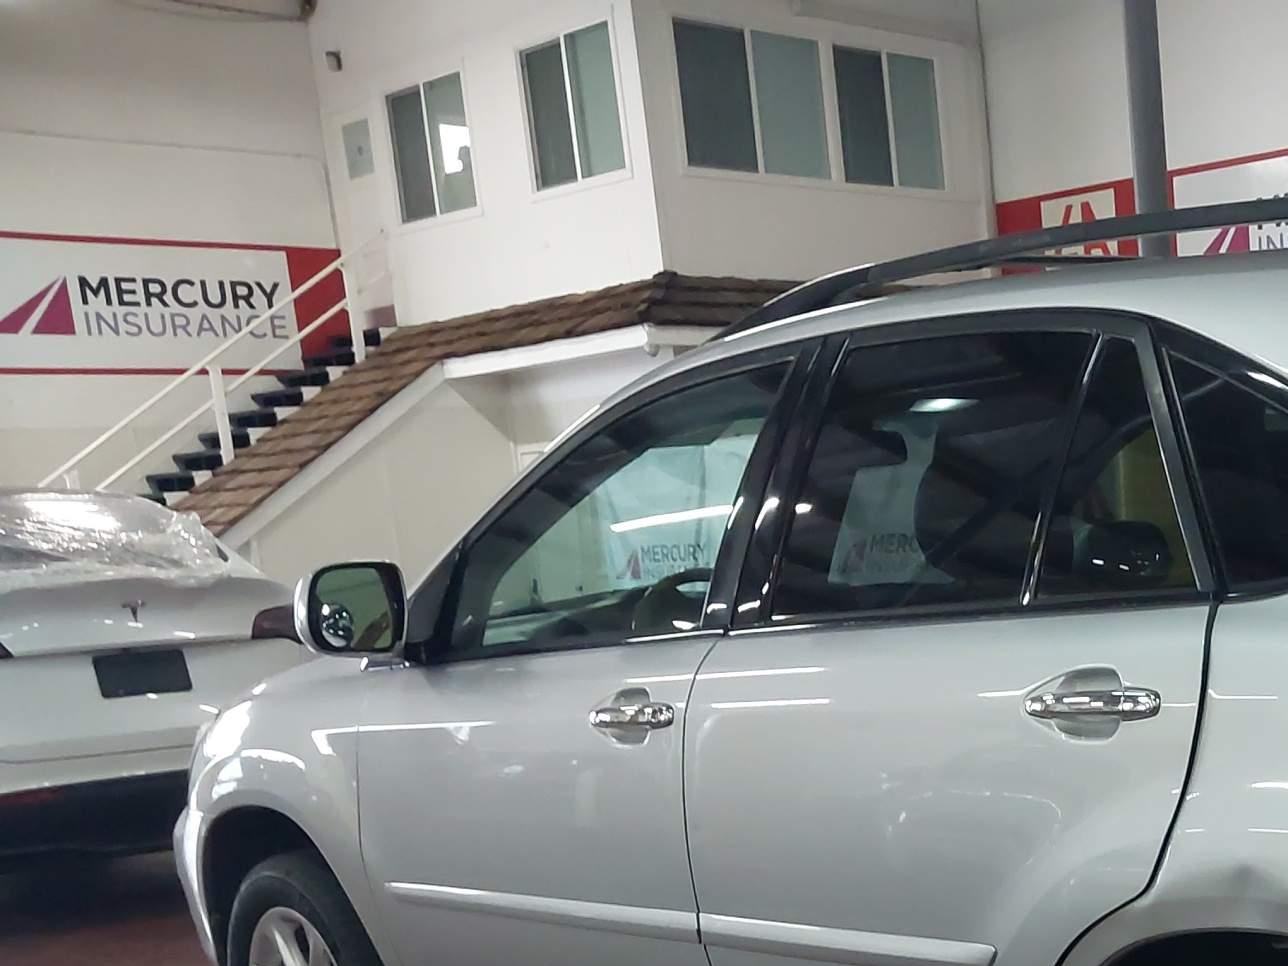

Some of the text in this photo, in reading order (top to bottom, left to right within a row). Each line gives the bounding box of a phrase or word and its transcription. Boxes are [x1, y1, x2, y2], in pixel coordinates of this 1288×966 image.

[77, 275, 280, 310] MERCURY
[84, 310, 290, 339] INSURANCE
[640, 543, 705, 564] MERCURY
